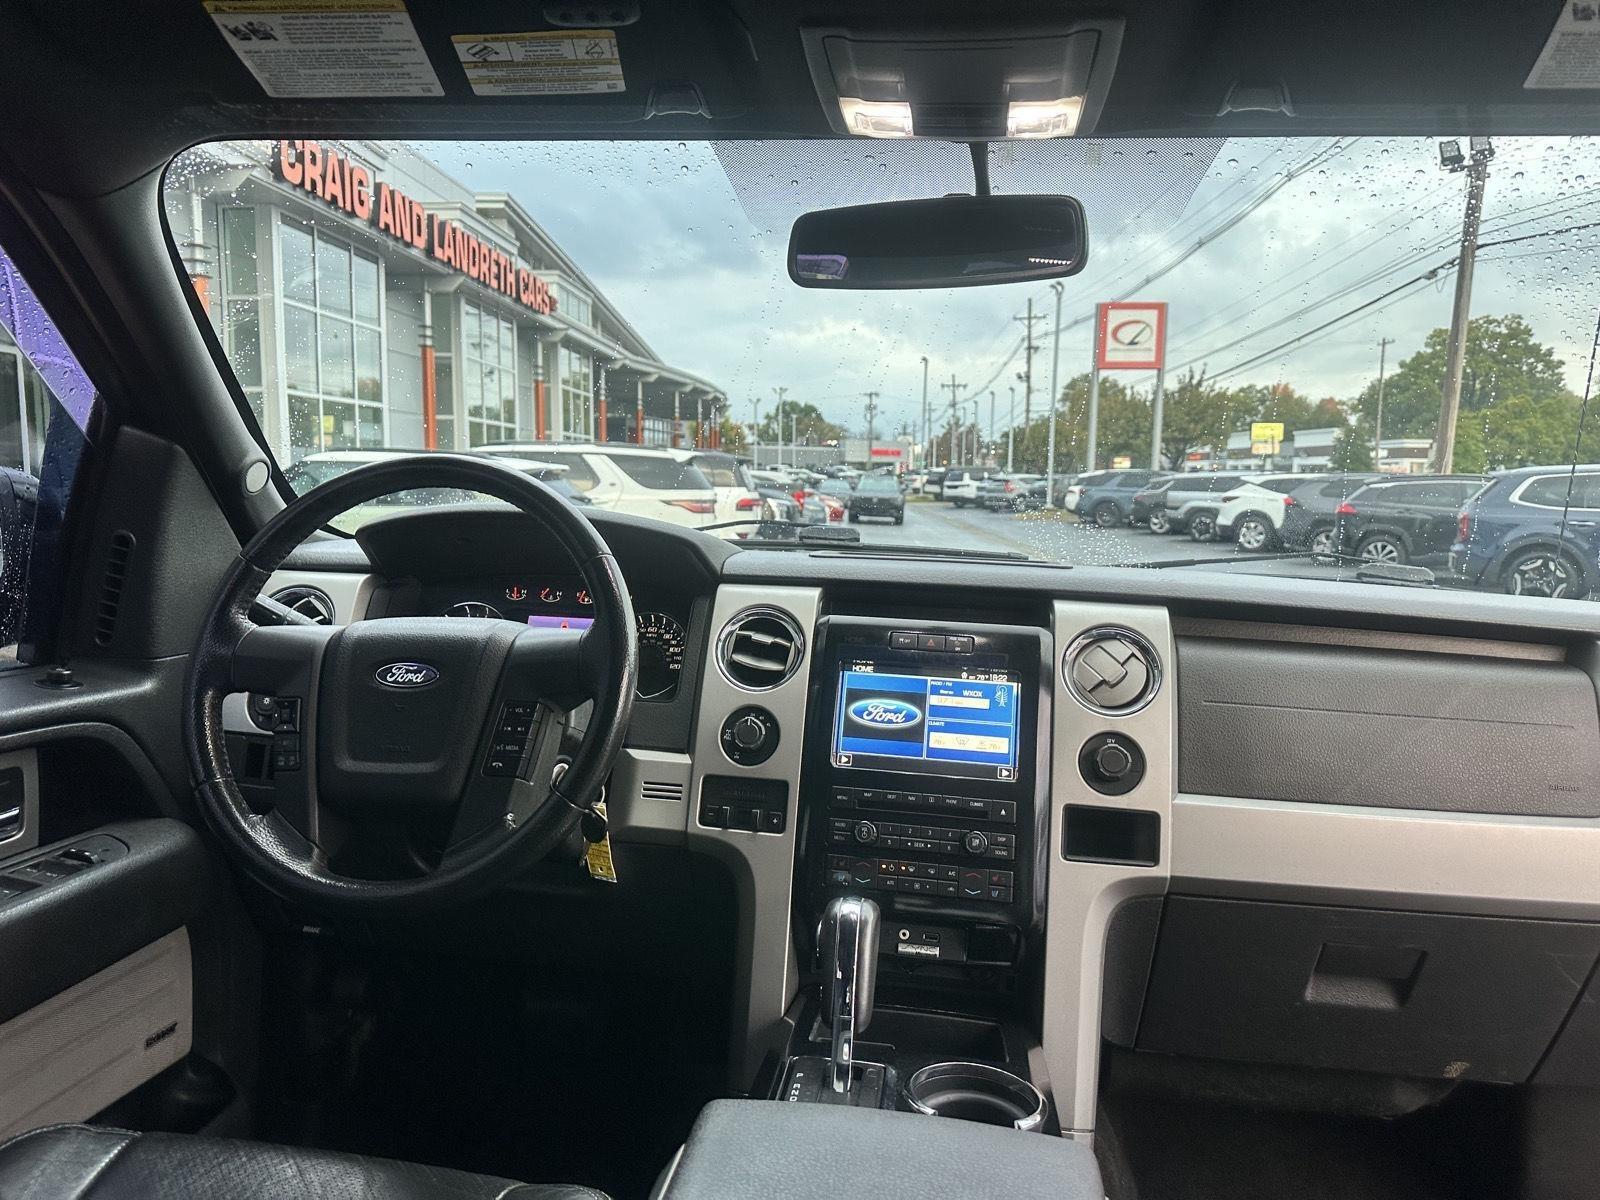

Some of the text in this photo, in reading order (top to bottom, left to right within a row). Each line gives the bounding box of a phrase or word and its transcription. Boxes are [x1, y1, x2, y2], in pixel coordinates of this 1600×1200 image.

[277, 140, 552, 316] CRAIG AND LANDRETH CARS
[386, 664, 427, 683] Ford
[852, 664, 875, 673] HOME
[862, 703, 906, 723] Ford
